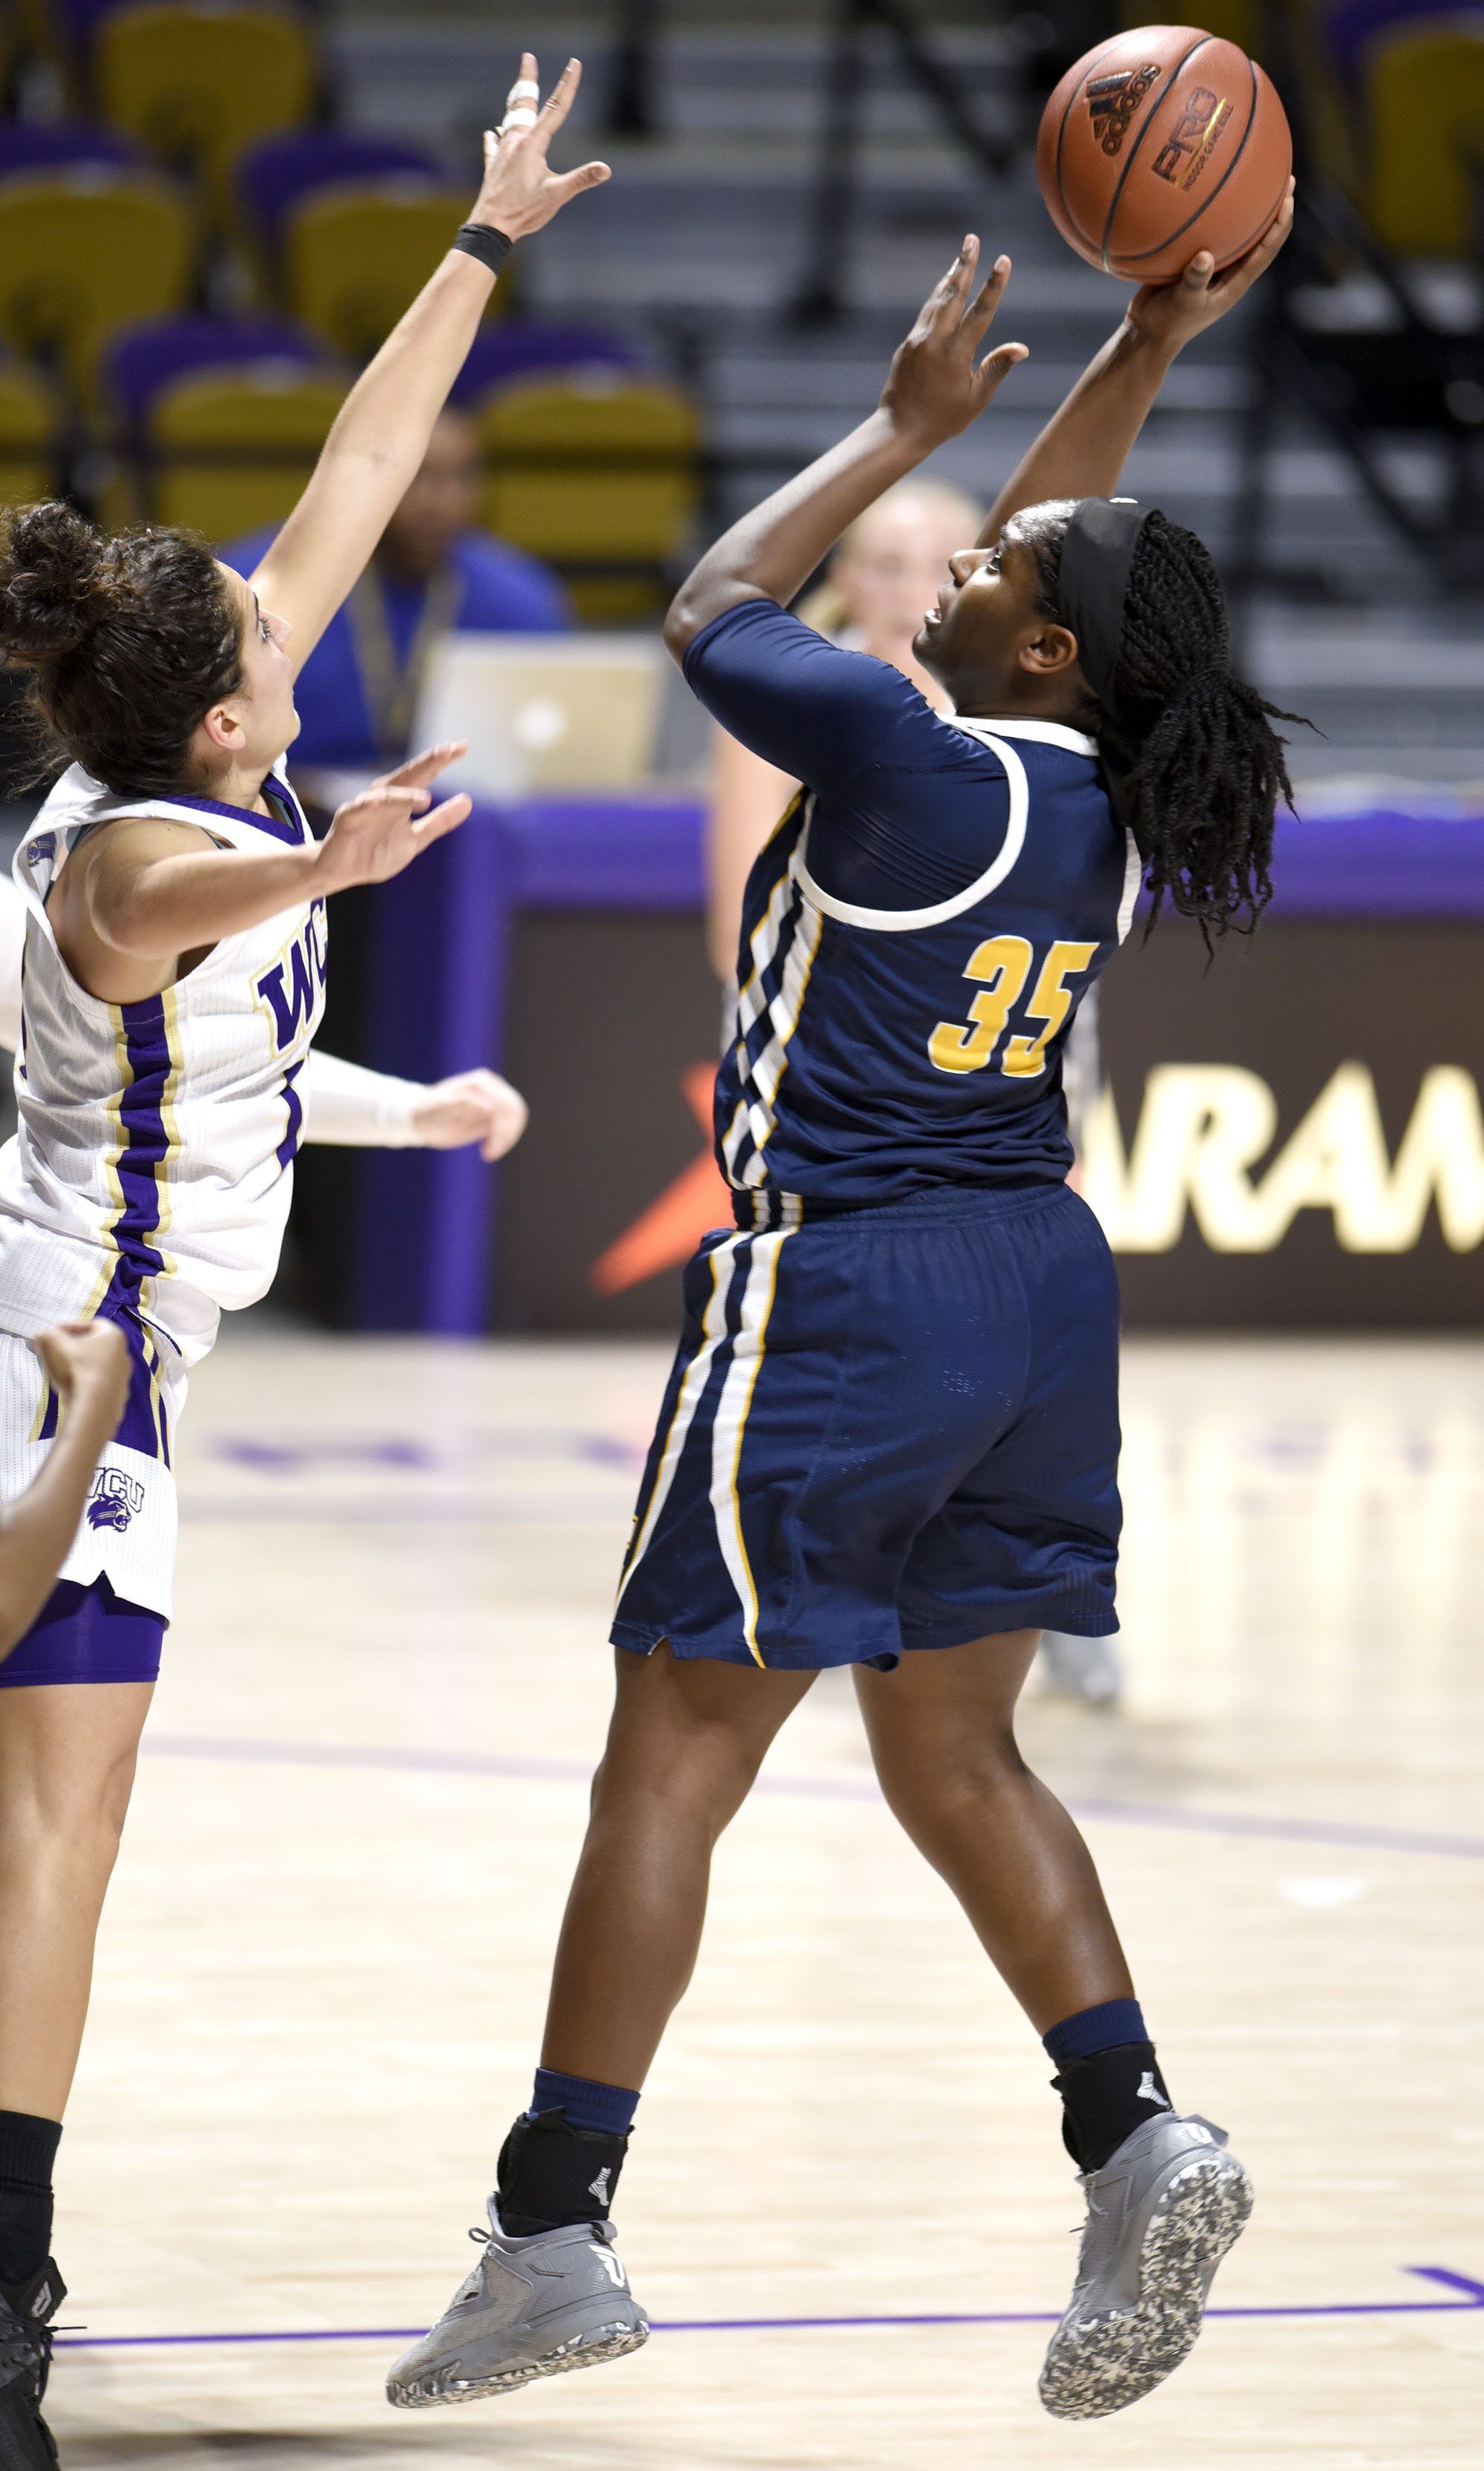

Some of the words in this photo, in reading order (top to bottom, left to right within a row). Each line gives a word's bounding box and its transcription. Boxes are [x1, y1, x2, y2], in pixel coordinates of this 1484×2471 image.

[1102, 65, 1160, 156] adidas
[1152, 87, 1217, 183] PRO
[928, 935, 1100, 1078] 35
